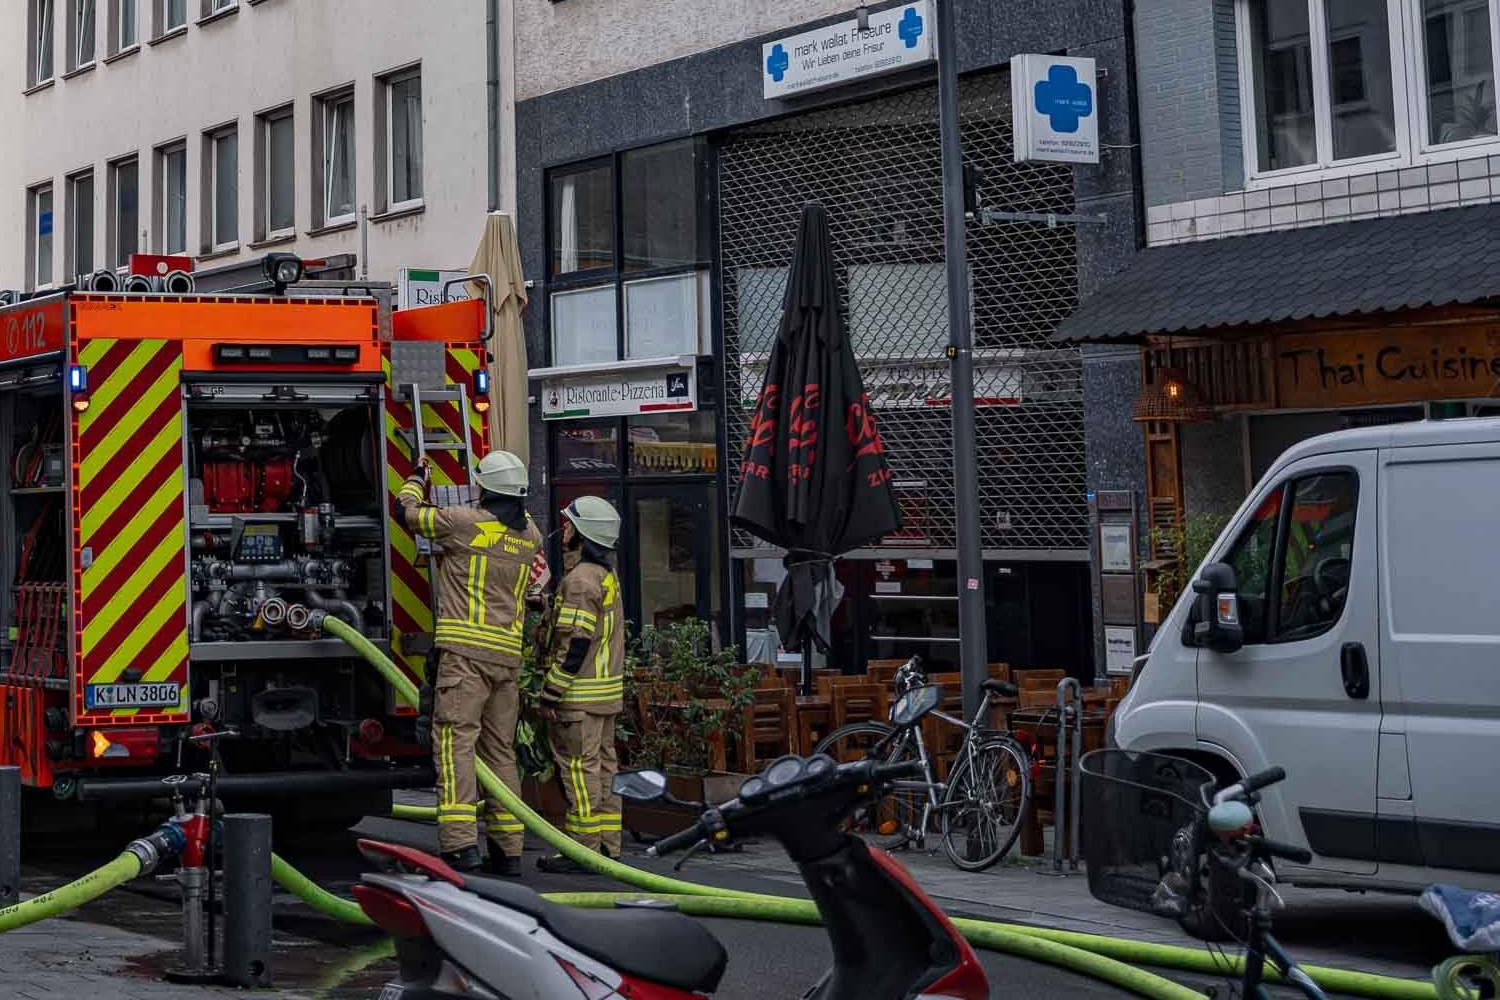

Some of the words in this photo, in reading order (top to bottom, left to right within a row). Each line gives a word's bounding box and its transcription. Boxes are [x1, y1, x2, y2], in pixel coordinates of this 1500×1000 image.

[794, 39, 818, 58] mark
[821, 33, 848, 51] wallat
[851, 21, 892, 43] Friseure
[802, 58, 815, 71] Wir
[817, 53, 840, 67] Lieben
[843, 48, 861, 60] deine
[863, 41, 885, 56] Frisur
[22, 312, 45, 351] 112
[1280, 349, 1365, 390] Thai
[1376, 346, 1500, 380] Cuisine
[504, 544, 519, 553] Köln
[96, 687, 106, 703] K
[116, 686, 137, 703] LN
[139, 685, 178, 702] 3806
